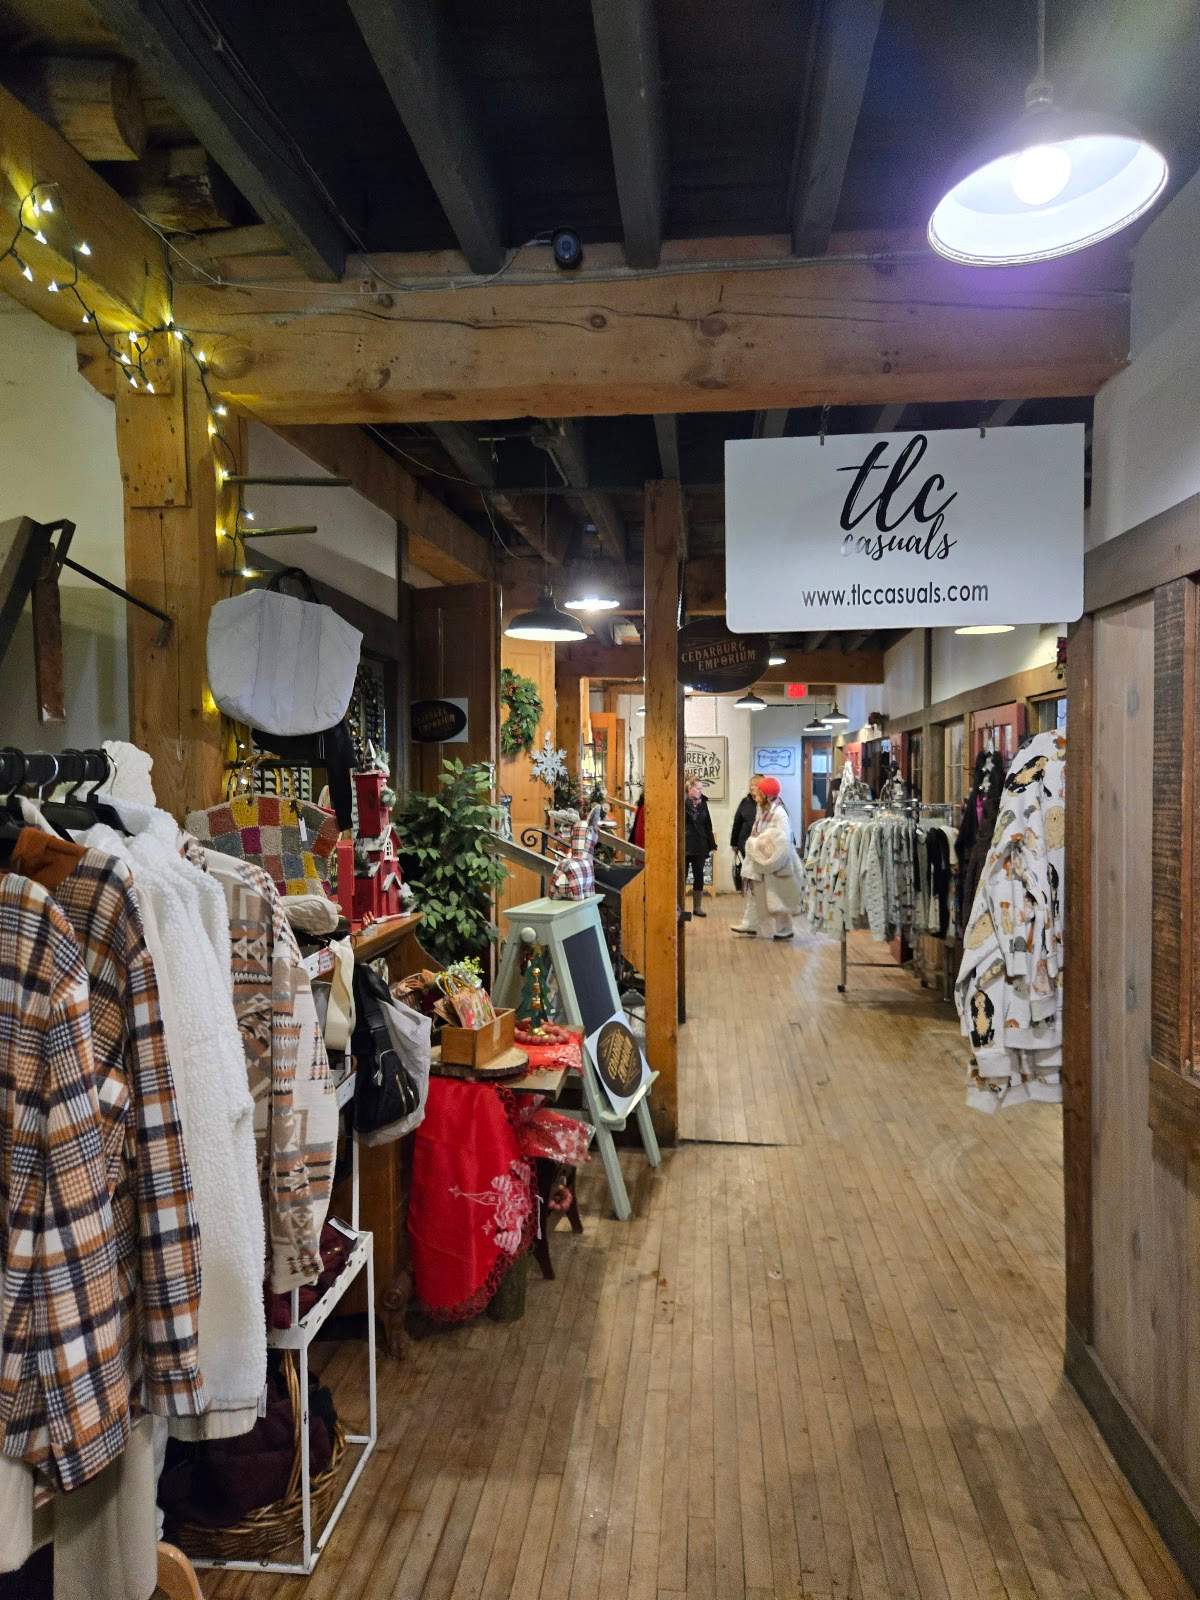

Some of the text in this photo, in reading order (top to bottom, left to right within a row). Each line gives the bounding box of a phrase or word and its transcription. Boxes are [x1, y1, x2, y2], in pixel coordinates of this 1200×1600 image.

[836, 434, 958, 532] tlc
[840, 513, 957, 561] casuals
[802, 581, 989, 607] www.tlccasuals.com
[698, 649, 756, 671] EMPORIUM
[685, 752, 707, 766] REEK
